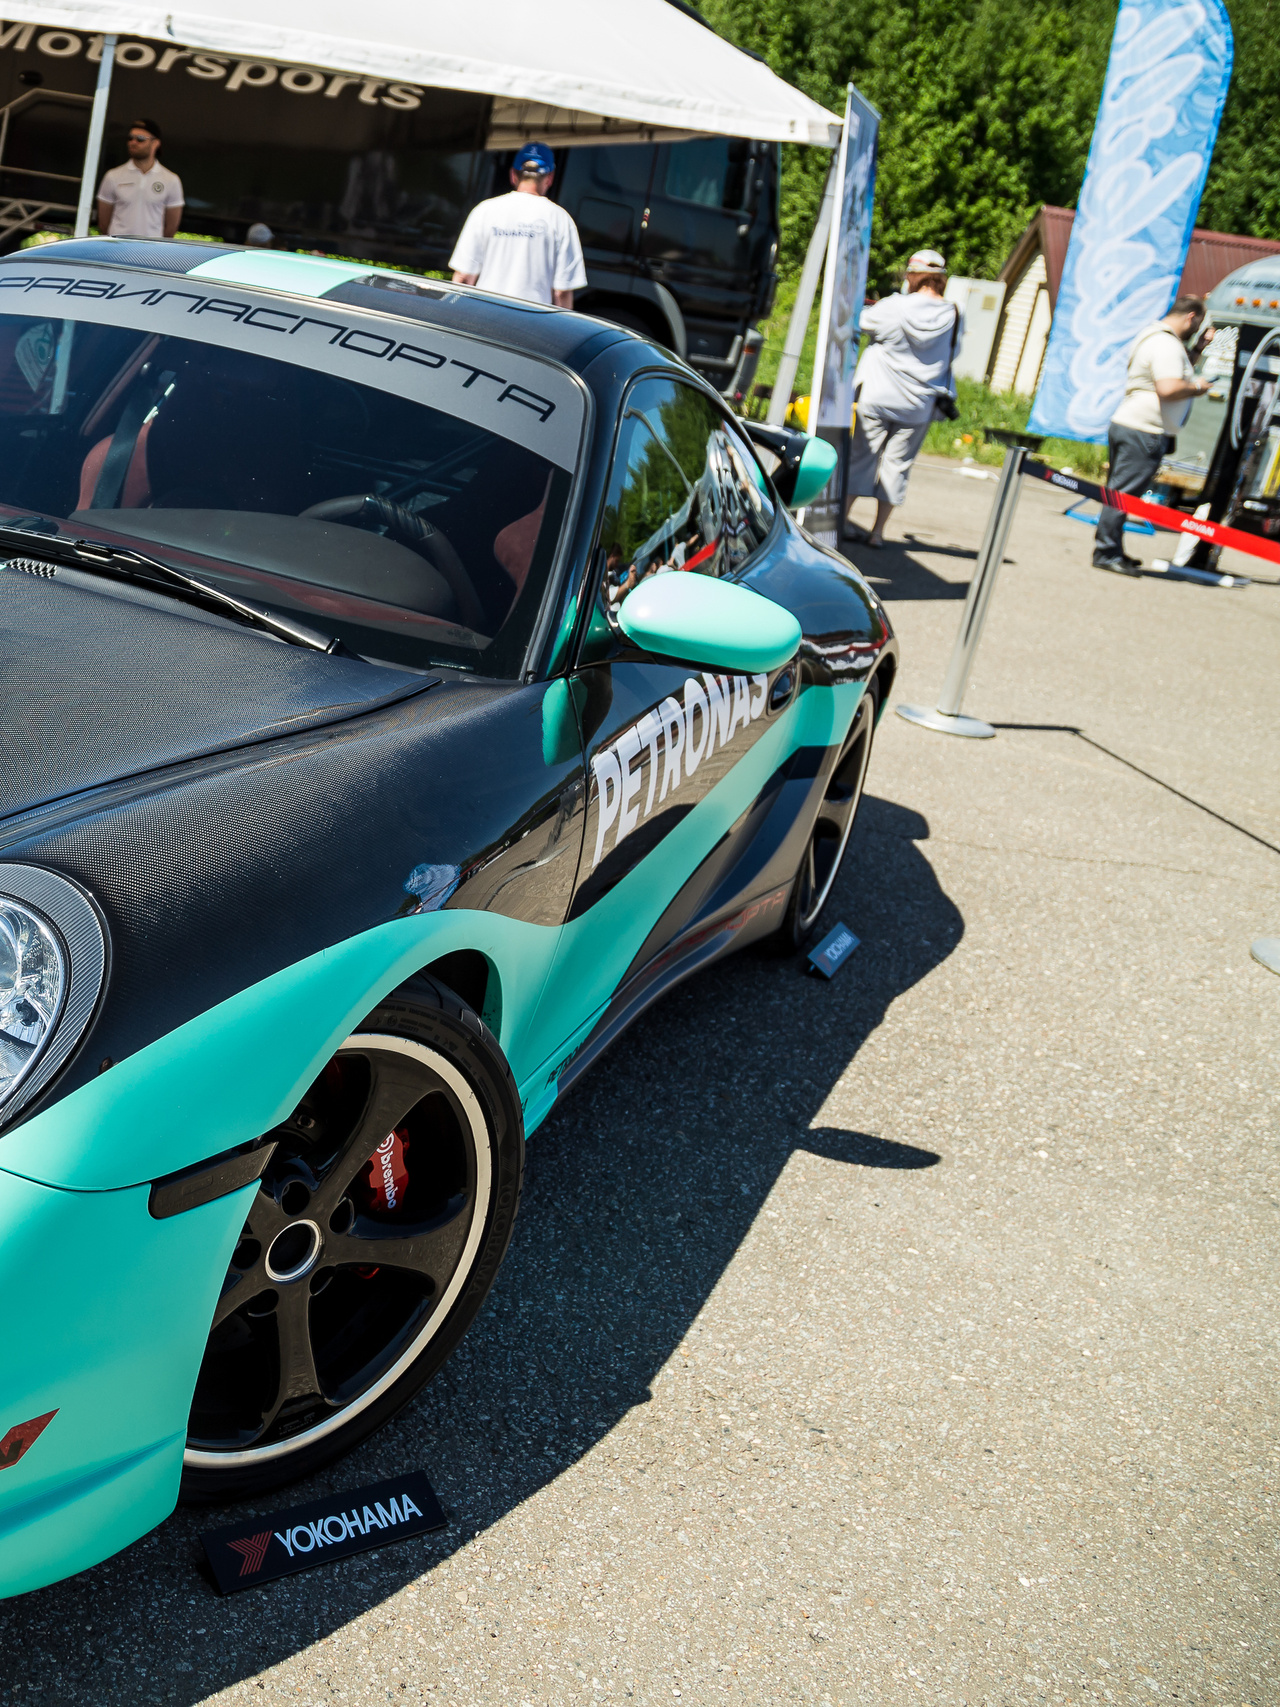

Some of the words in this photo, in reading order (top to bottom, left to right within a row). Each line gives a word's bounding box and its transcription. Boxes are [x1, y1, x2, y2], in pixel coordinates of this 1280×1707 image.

[1180, 519, 1216, 537] ADVAN
[592, 672, 769, 869] PETRONAS
[380, 1150, 399, 1209] brembo
[273, 1493, 424, 1557] YOKOHAMA
